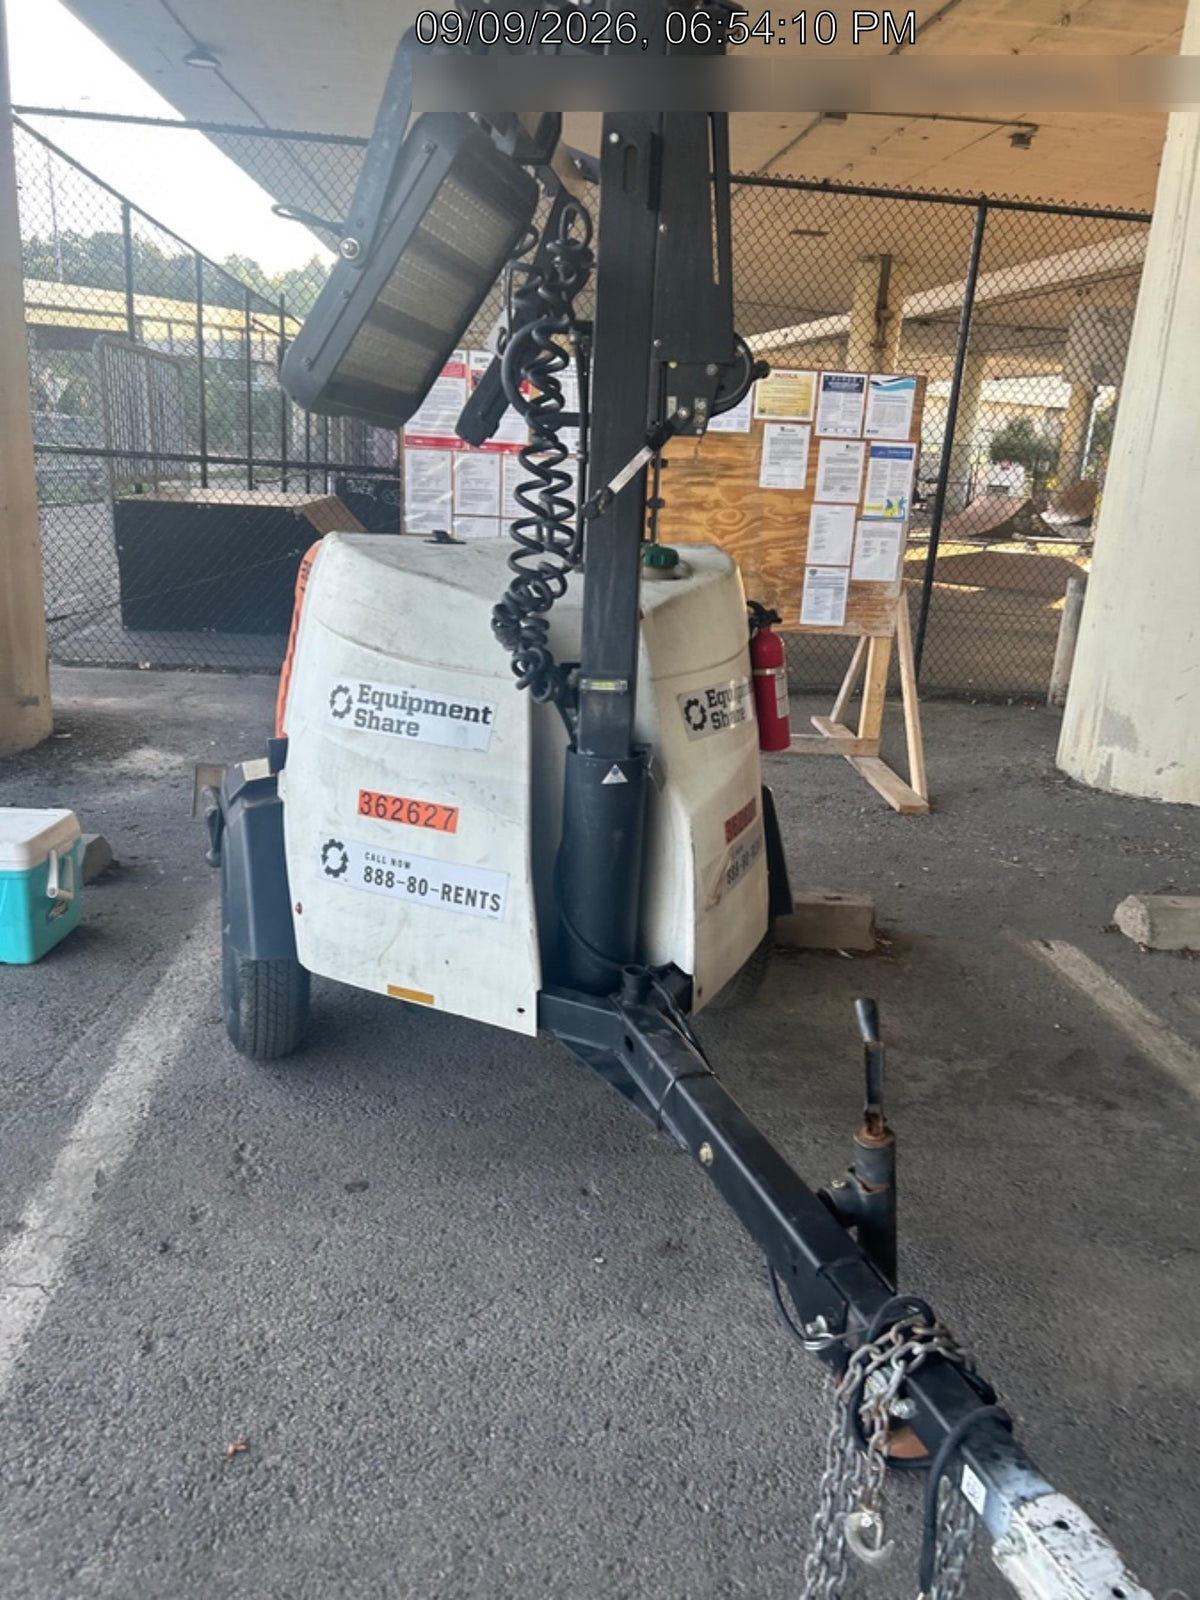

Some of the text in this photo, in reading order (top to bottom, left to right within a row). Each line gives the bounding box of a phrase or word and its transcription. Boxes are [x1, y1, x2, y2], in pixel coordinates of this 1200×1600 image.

[354, 708, 420, 737] Share
[356, 683, 492, 725] Equipment
[360, 791, 455, 831] 362627
[364, 851, 411, 869] CALL NOW
[363, 865, 501, 912] 888-80-RENTS
